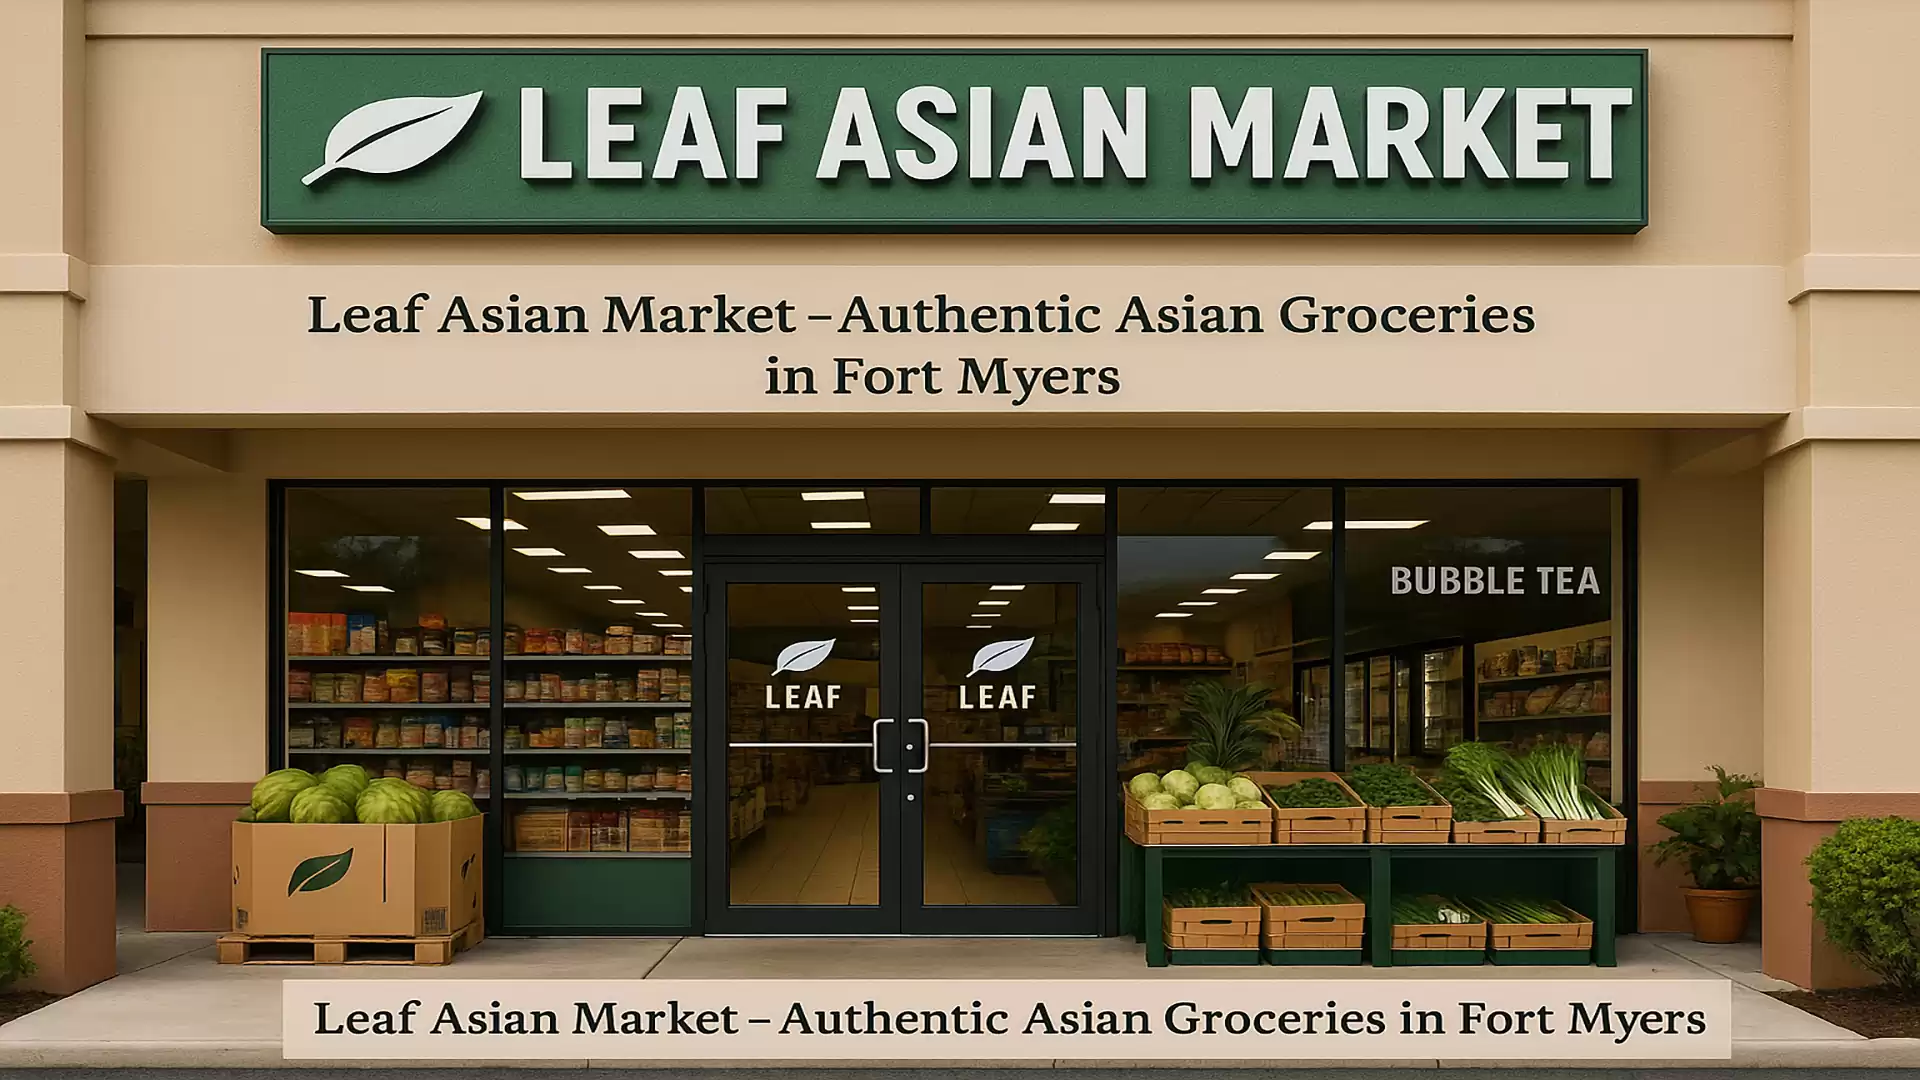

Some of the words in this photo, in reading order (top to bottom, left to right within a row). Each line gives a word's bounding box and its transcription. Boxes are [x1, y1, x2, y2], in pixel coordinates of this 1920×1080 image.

[520, 86, 787, 179] LEAF
[815, 85, 1147, 180] ASIAN
[1190, 86, 1633, 179] MARKET
[307, 292, 431, 334] Leaf
[436, 293, 589, 334] Asian
[601, 293, 797, 334] Market
[837, 293, 1101, 334] Authentic
[1114, 294, 1265, 334] Asian
[1279, 293, 1535, 334] Groceries
[764, 355, 819, 395] in
[832, 357, 943, 395] Fort
[957, 357, 1120, 407] Myers
[1390, 565, 1526, 596] BUBBLE
[1535, 565, 1602, 596] TEA
[765, 684, 842, 710] LEAF
[958, 684, 1037, 710] LEAF
